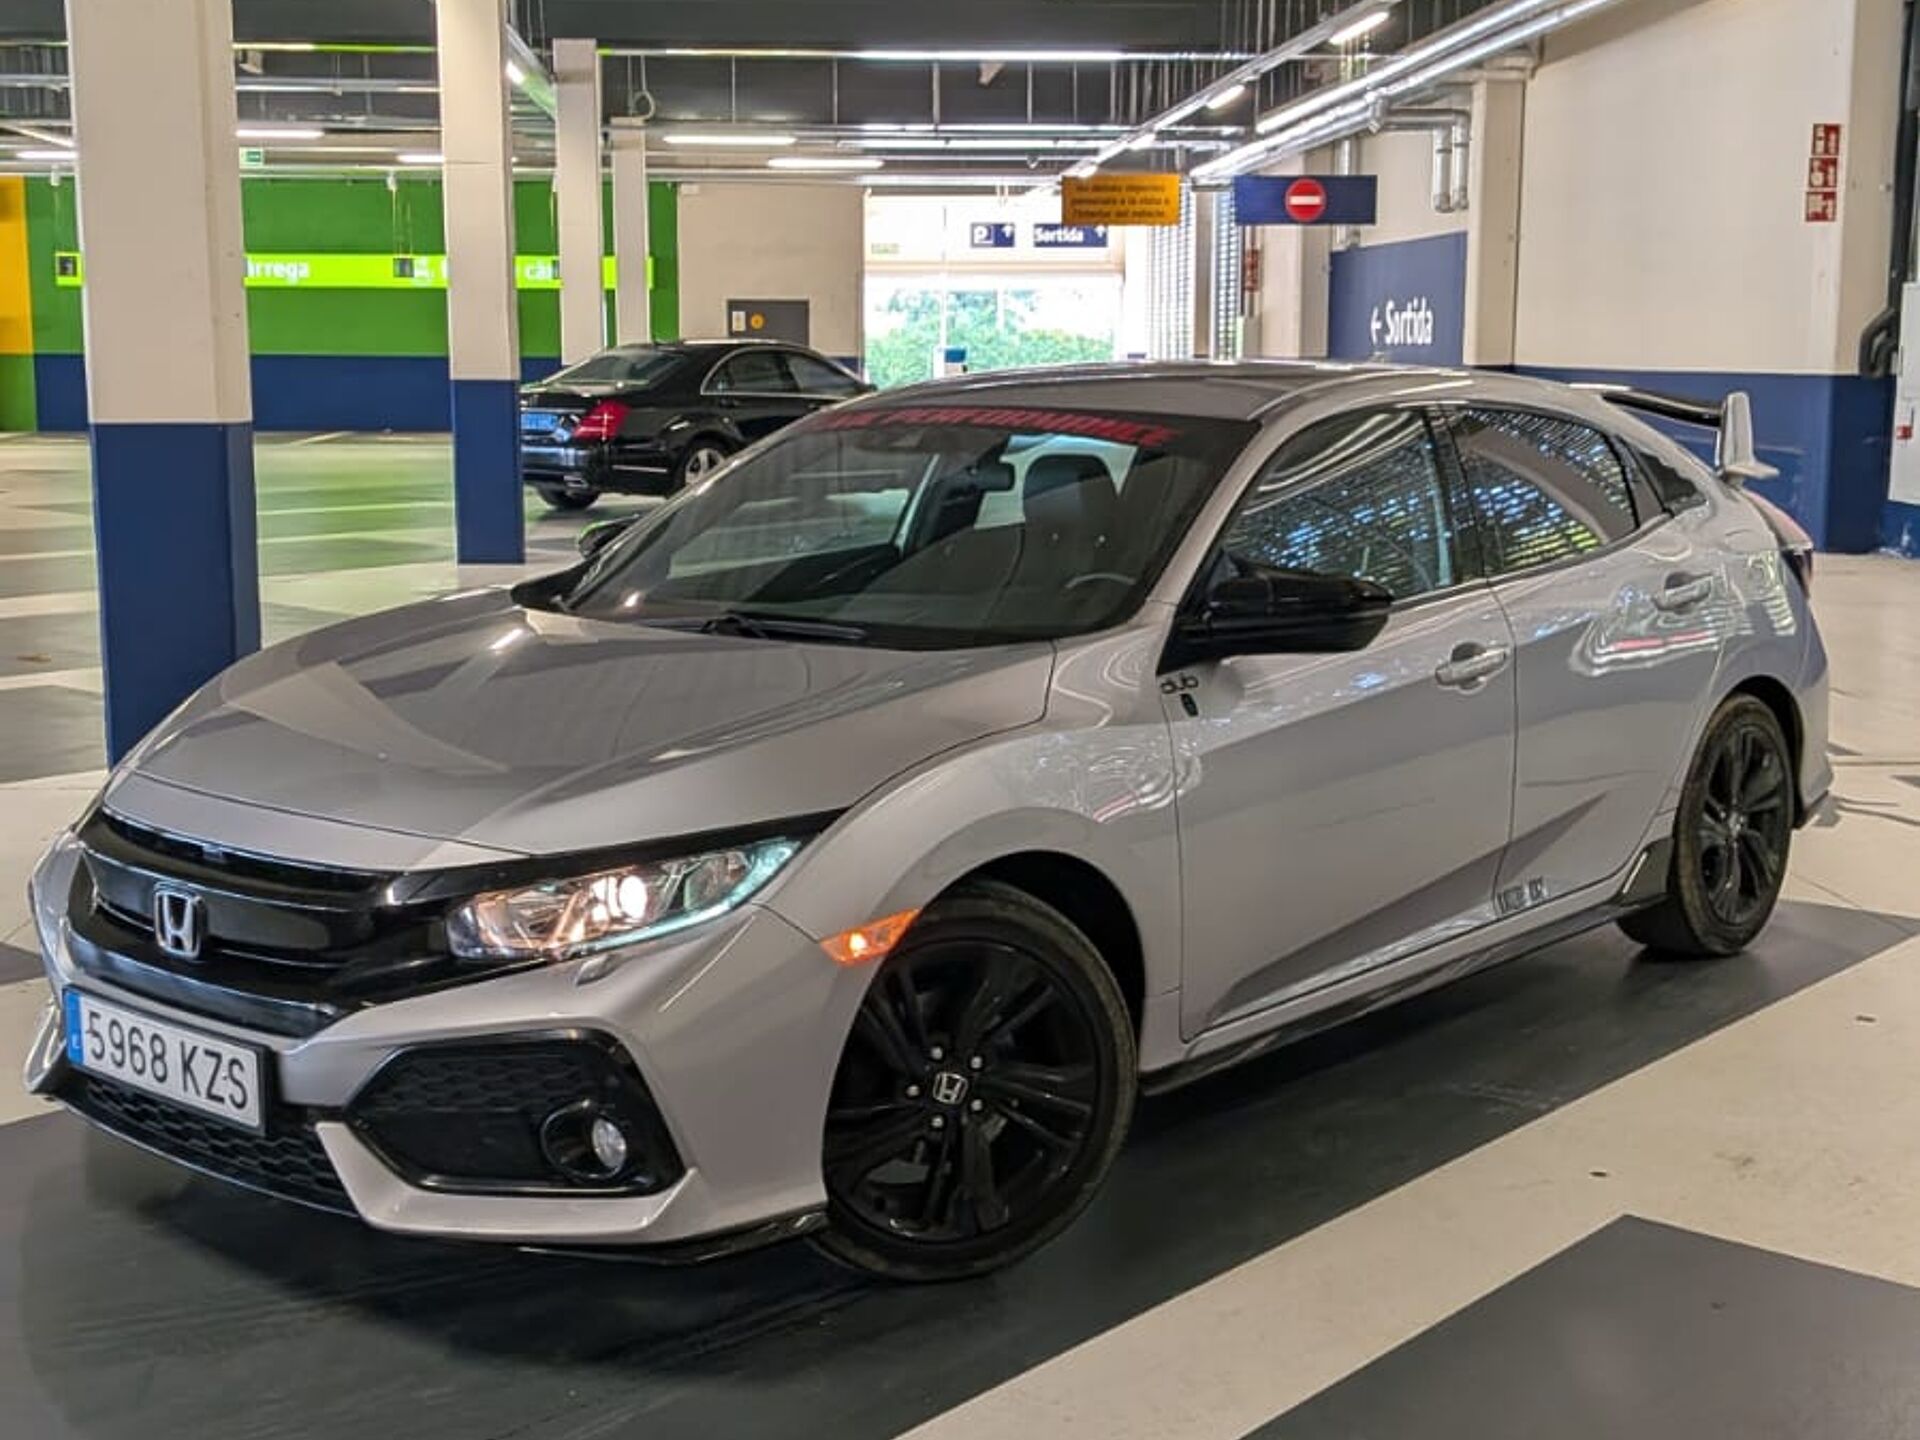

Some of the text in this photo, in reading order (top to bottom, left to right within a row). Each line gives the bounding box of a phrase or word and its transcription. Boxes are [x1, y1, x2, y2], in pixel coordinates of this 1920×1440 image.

[1033, 226, 1084, 243] Sortida
[1384, 296, 1434, 345] Sortida
[86, 1010, 248, 1110] 5968 KZS
